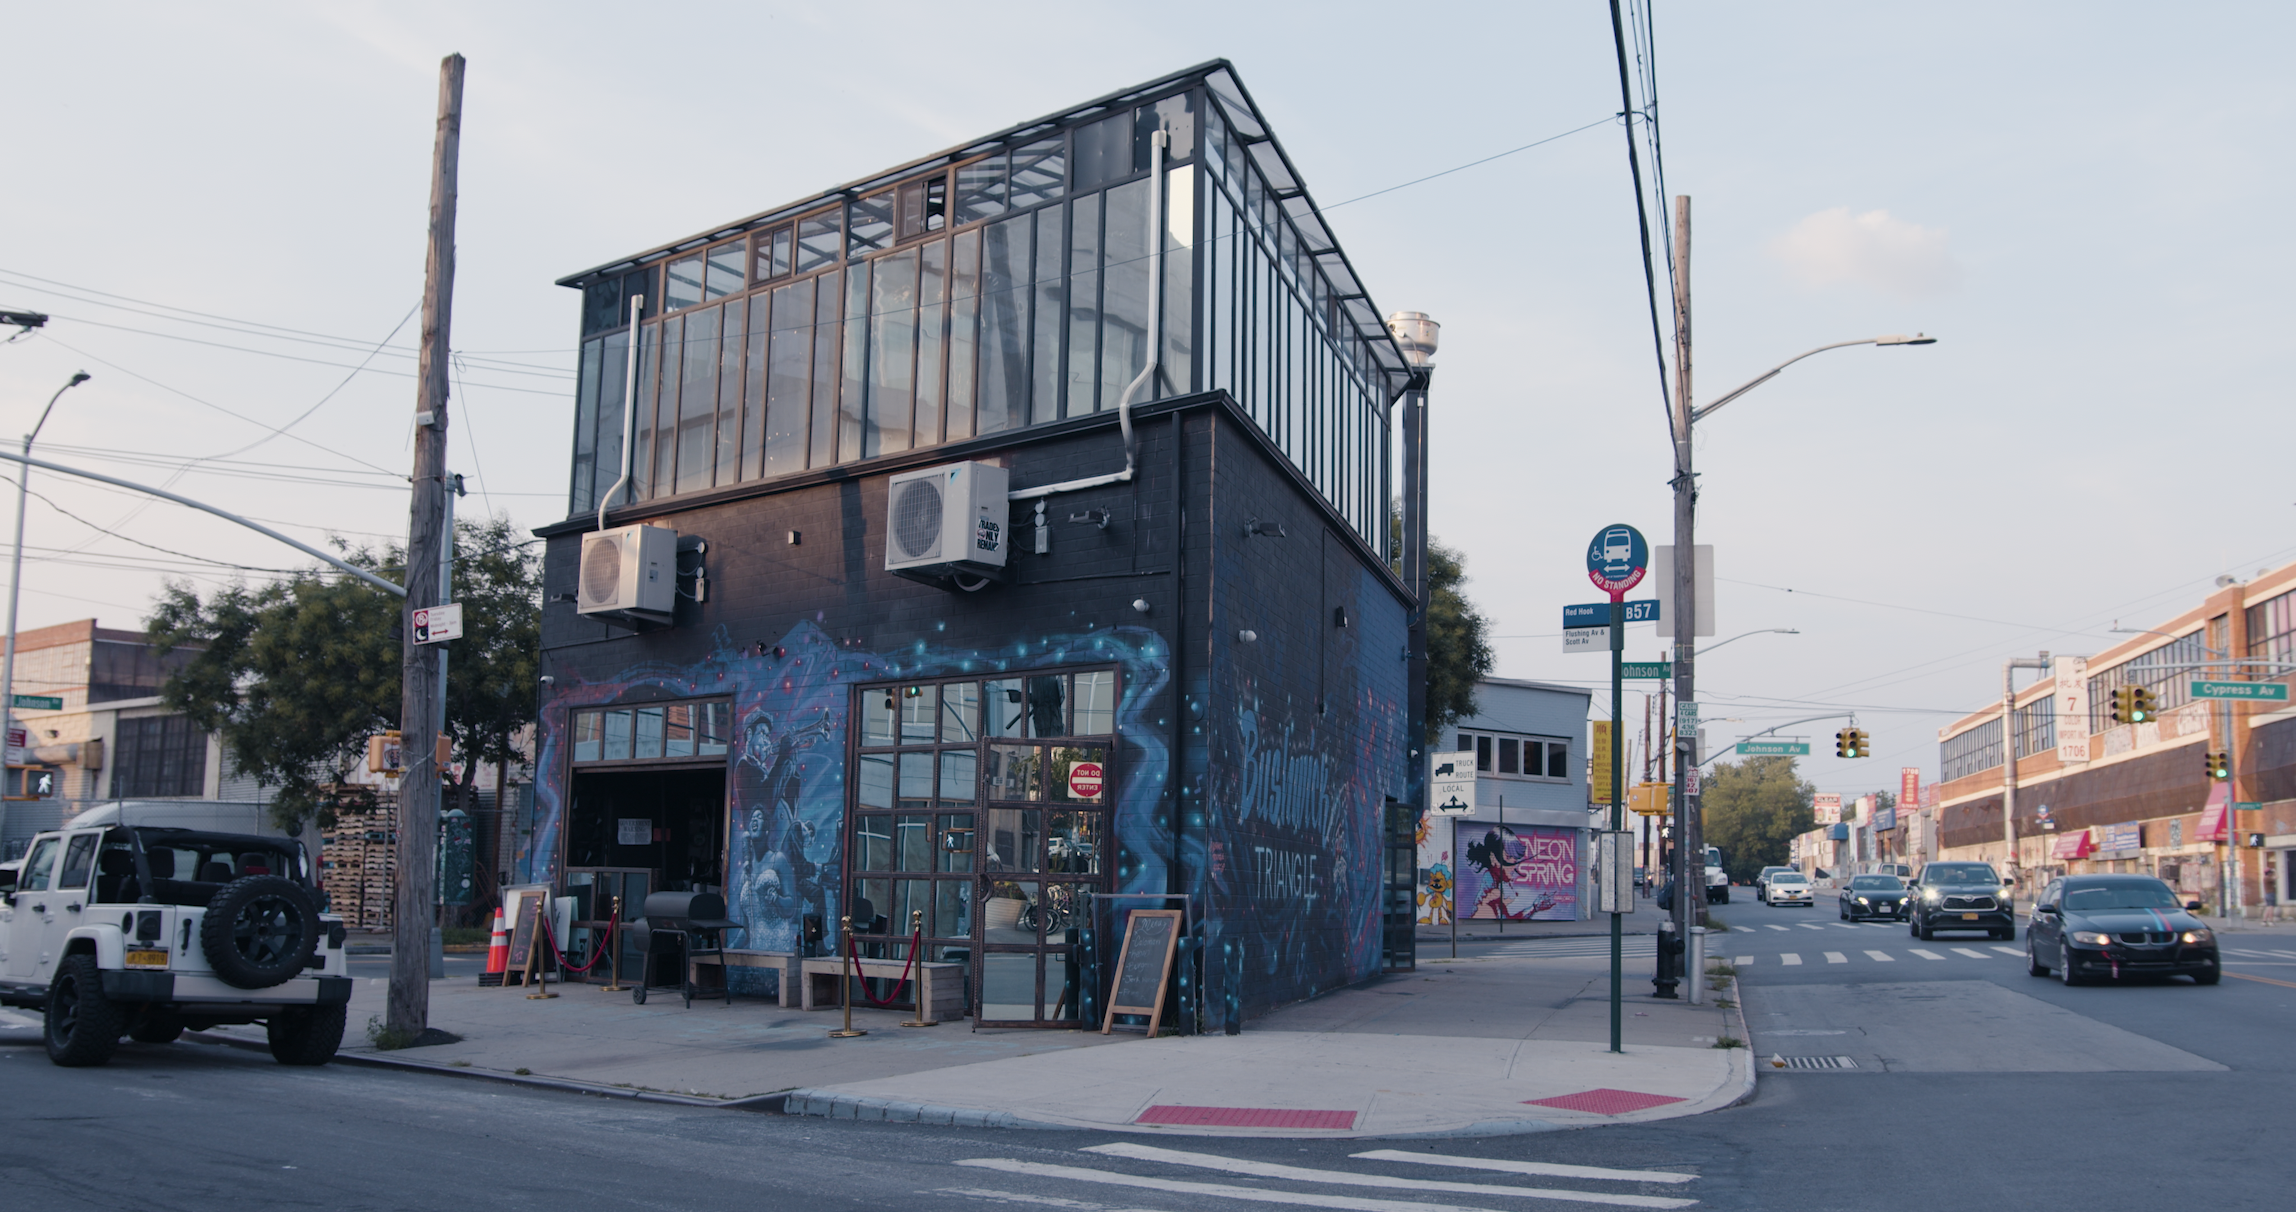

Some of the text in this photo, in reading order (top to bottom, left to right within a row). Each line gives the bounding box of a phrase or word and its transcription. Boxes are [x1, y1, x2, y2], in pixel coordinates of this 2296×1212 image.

[1592, 570, 1641, 590] NO STANDING
[1565, 607, 1594, 616] Red Hook
[1625, 603, 1652, 620] B57
[1565, 638, 1581, 646] Scott
[1622, 665, 1659, 677] ohnson
[2203, 683, 2275, 696] Cypress Av
[16, 697, 50, 709] Johnson
[2067, 697, 2077, 711] 7
[2062, 745, 2086, 757] 1706
[1238, 709, 1330, 849] Bushwick
[1520, 835, 1574, 861] NEON
[1255, 847, 1318, 899] TRIANGLE
[1516, 859, 1574, 888] SPRING
